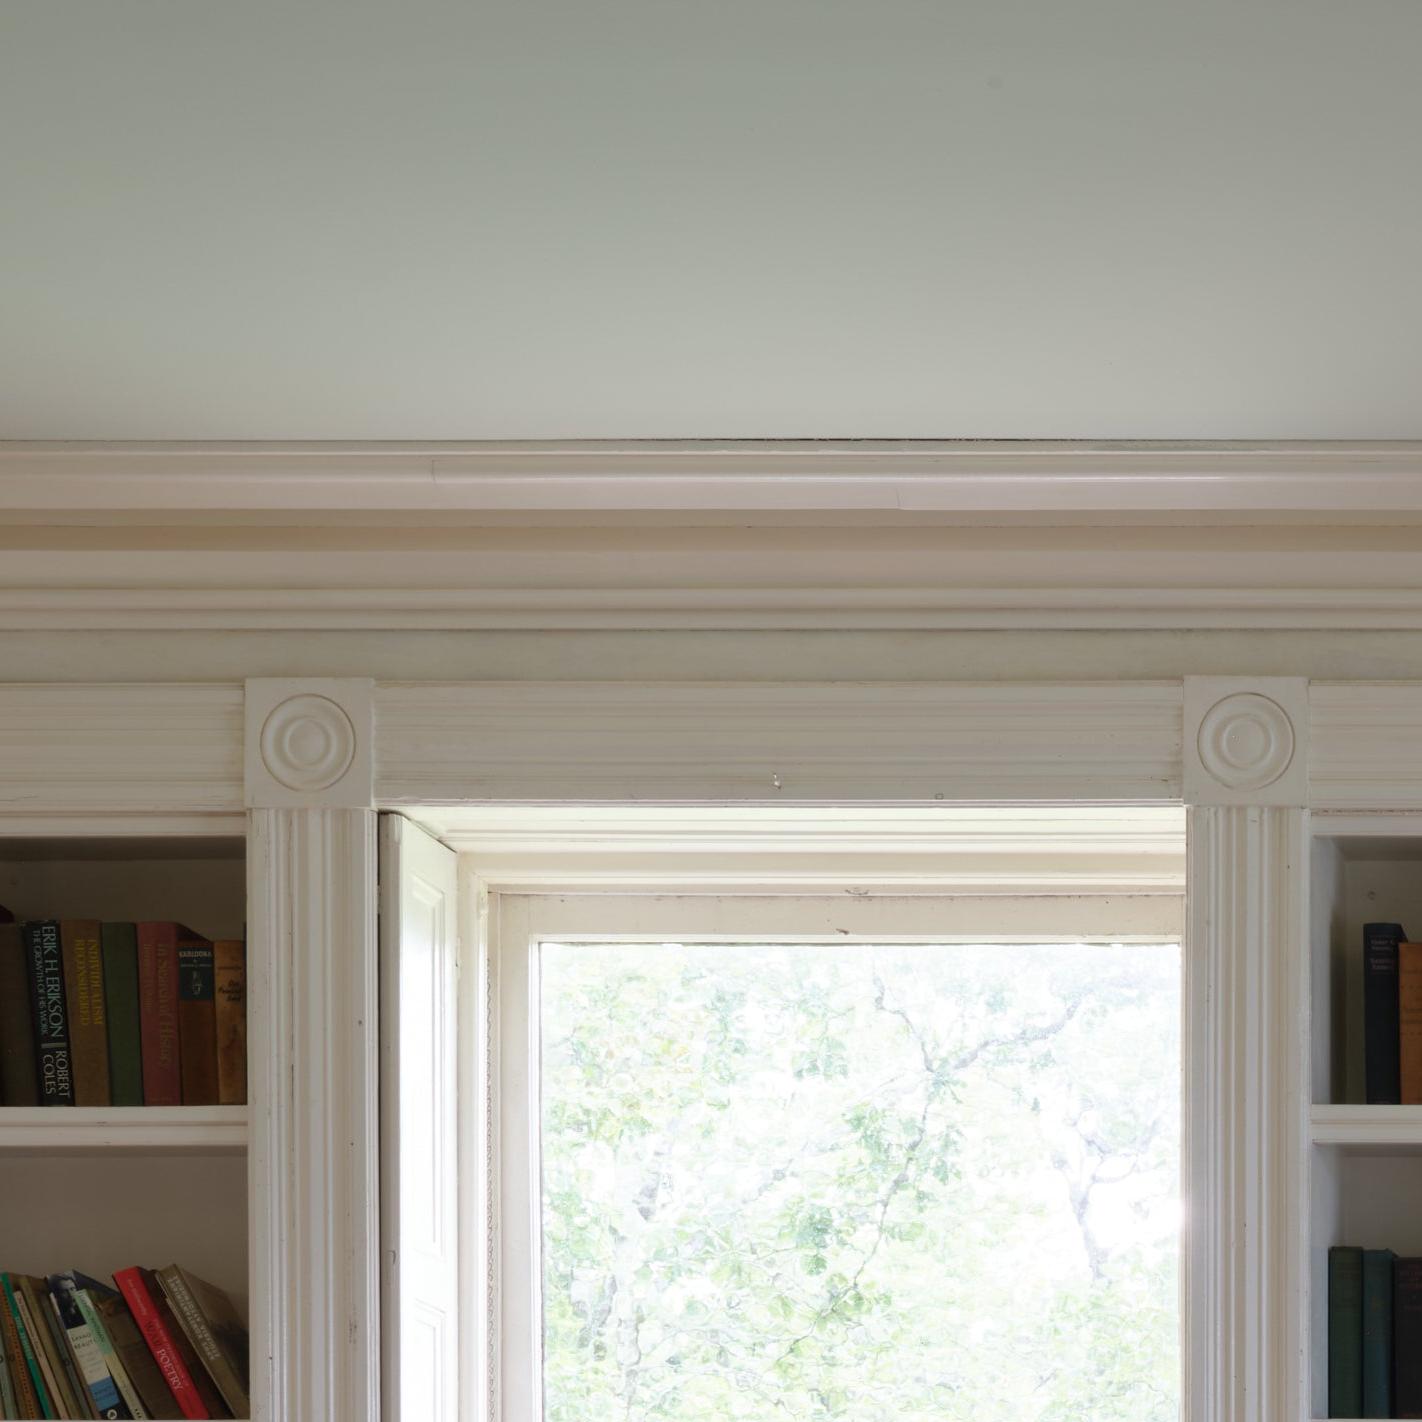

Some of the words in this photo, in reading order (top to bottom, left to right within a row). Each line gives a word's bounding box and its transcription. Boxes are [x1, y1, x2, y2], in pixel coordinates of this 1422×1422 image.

[41, 926, 57, 954] ERIK
[45, 976, 64, 1038] ERIKSON
[42, 1054, 57, 1095] COLES
[55, 1049, 71, 1098] ROBERT
